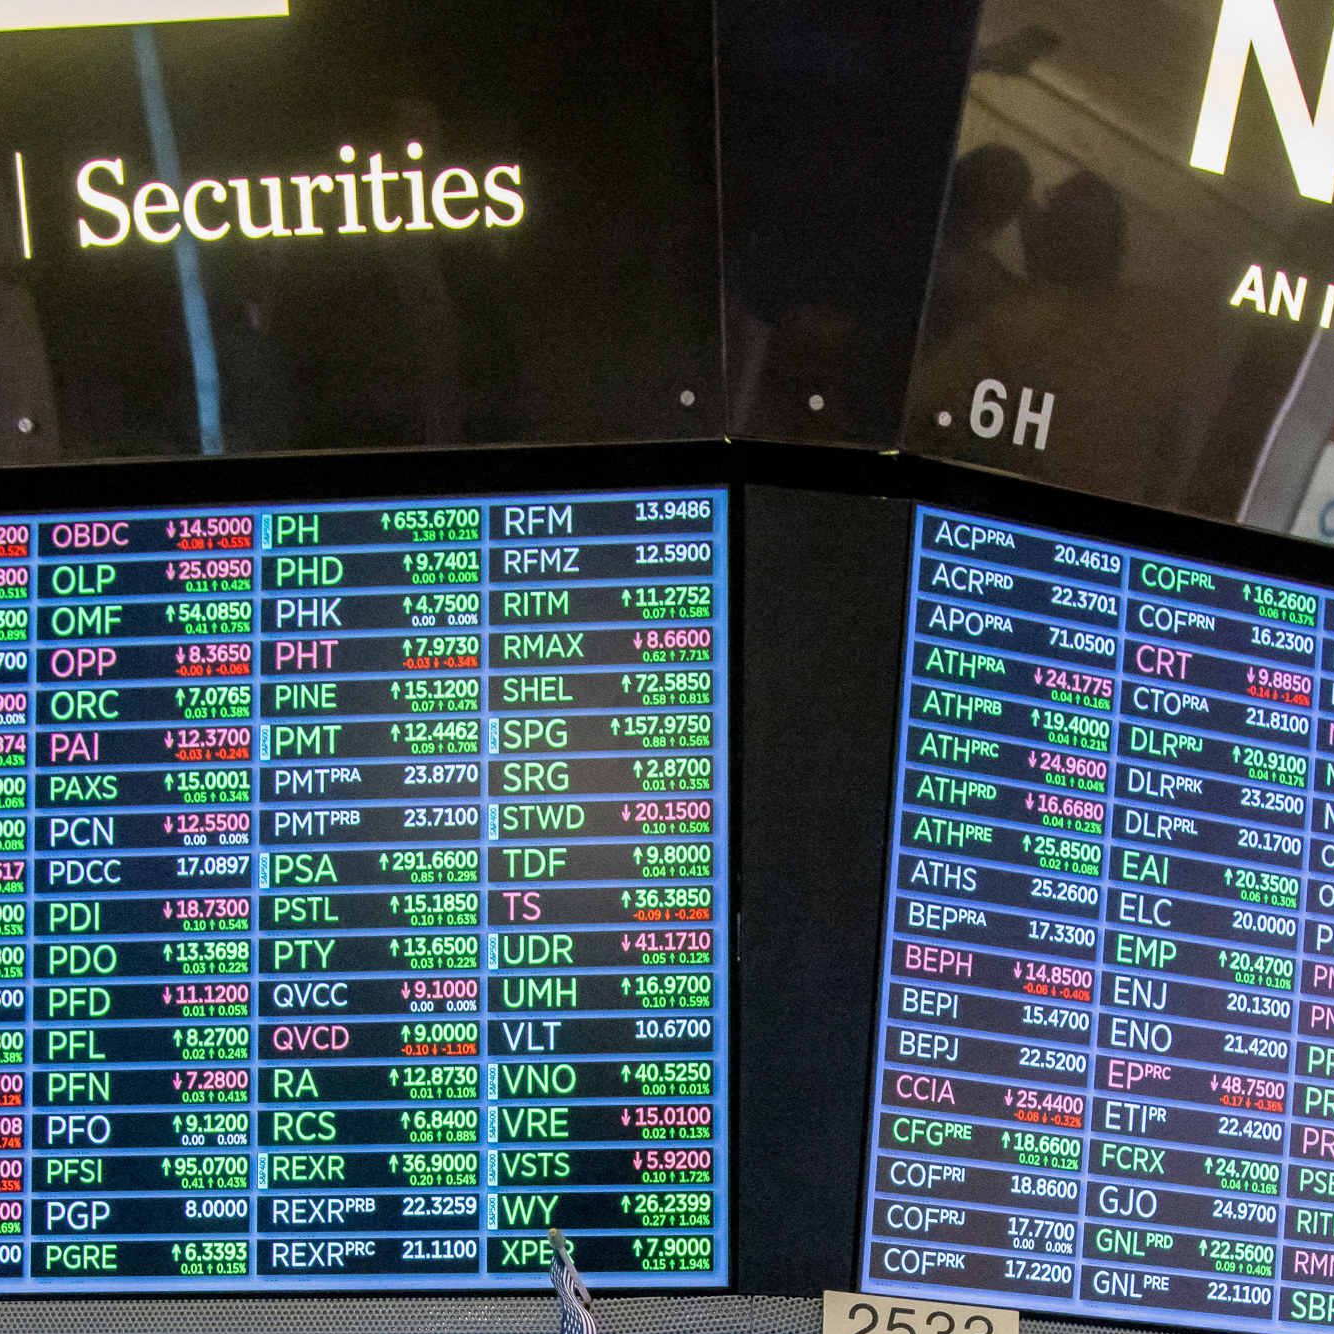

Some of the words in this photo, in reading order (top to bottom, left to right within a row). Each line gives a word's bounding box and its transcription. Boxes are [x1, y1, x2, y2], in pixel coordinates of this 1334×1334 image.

[76, 140, 526, 250] Securities
[1230, 263, 1307, 324] AN
[968, 378, 1057, 452] 6H
[53, 522, 128, 547] OBDC
[180, 518, 251, 539] 14.5000
[278, 515, 318, 544] PH
[394, 509, 479, 529] 653.6700
[414, 531, 435, 541] 1.38
[449, 529, 478, 540] 0.21%
[1055, 545, 1120, 573] 20.4619
[1052, 587, 1117, 615] 22.3701
[52, 606, 122, 636] OMF
[179, 602, 251, 622] 54.0850
[1137, 645, 1192, 678] CRT
[1257, 669, 1311, 694] 9.8850
[504, 677, 573, 702] SHEL
[636, 673, 710, 695] 72.5850
[275, 854, 337, 883] PSA
[392, 850, 478, 870] 291.6600
[1123, 851, 1168, 884] EAI
[1235, 870, 1298, 897] 20.3500
[906, 945, 972, 976] BEPH
[1024, 963, 1092, 990] 14.8500
[1117, 934, 1176, 968] EMP
[1230, 951, 1293, 978] 20.4700
[503, 1064, 576, 1094] VNO
[635, 1063, 710, 1082] 40.5250
[897, 1075, 956, 1104] CCIA
[1015, 1089, 1085, 1116] 25.4400
[48, 1159, 102, 1183] PFSI
[175, 1157, 248, 1176] 95.0700
[1100, 1184, 1159, 1218] GJO
[1213, 1199, 1278, 1223] 24.9700
